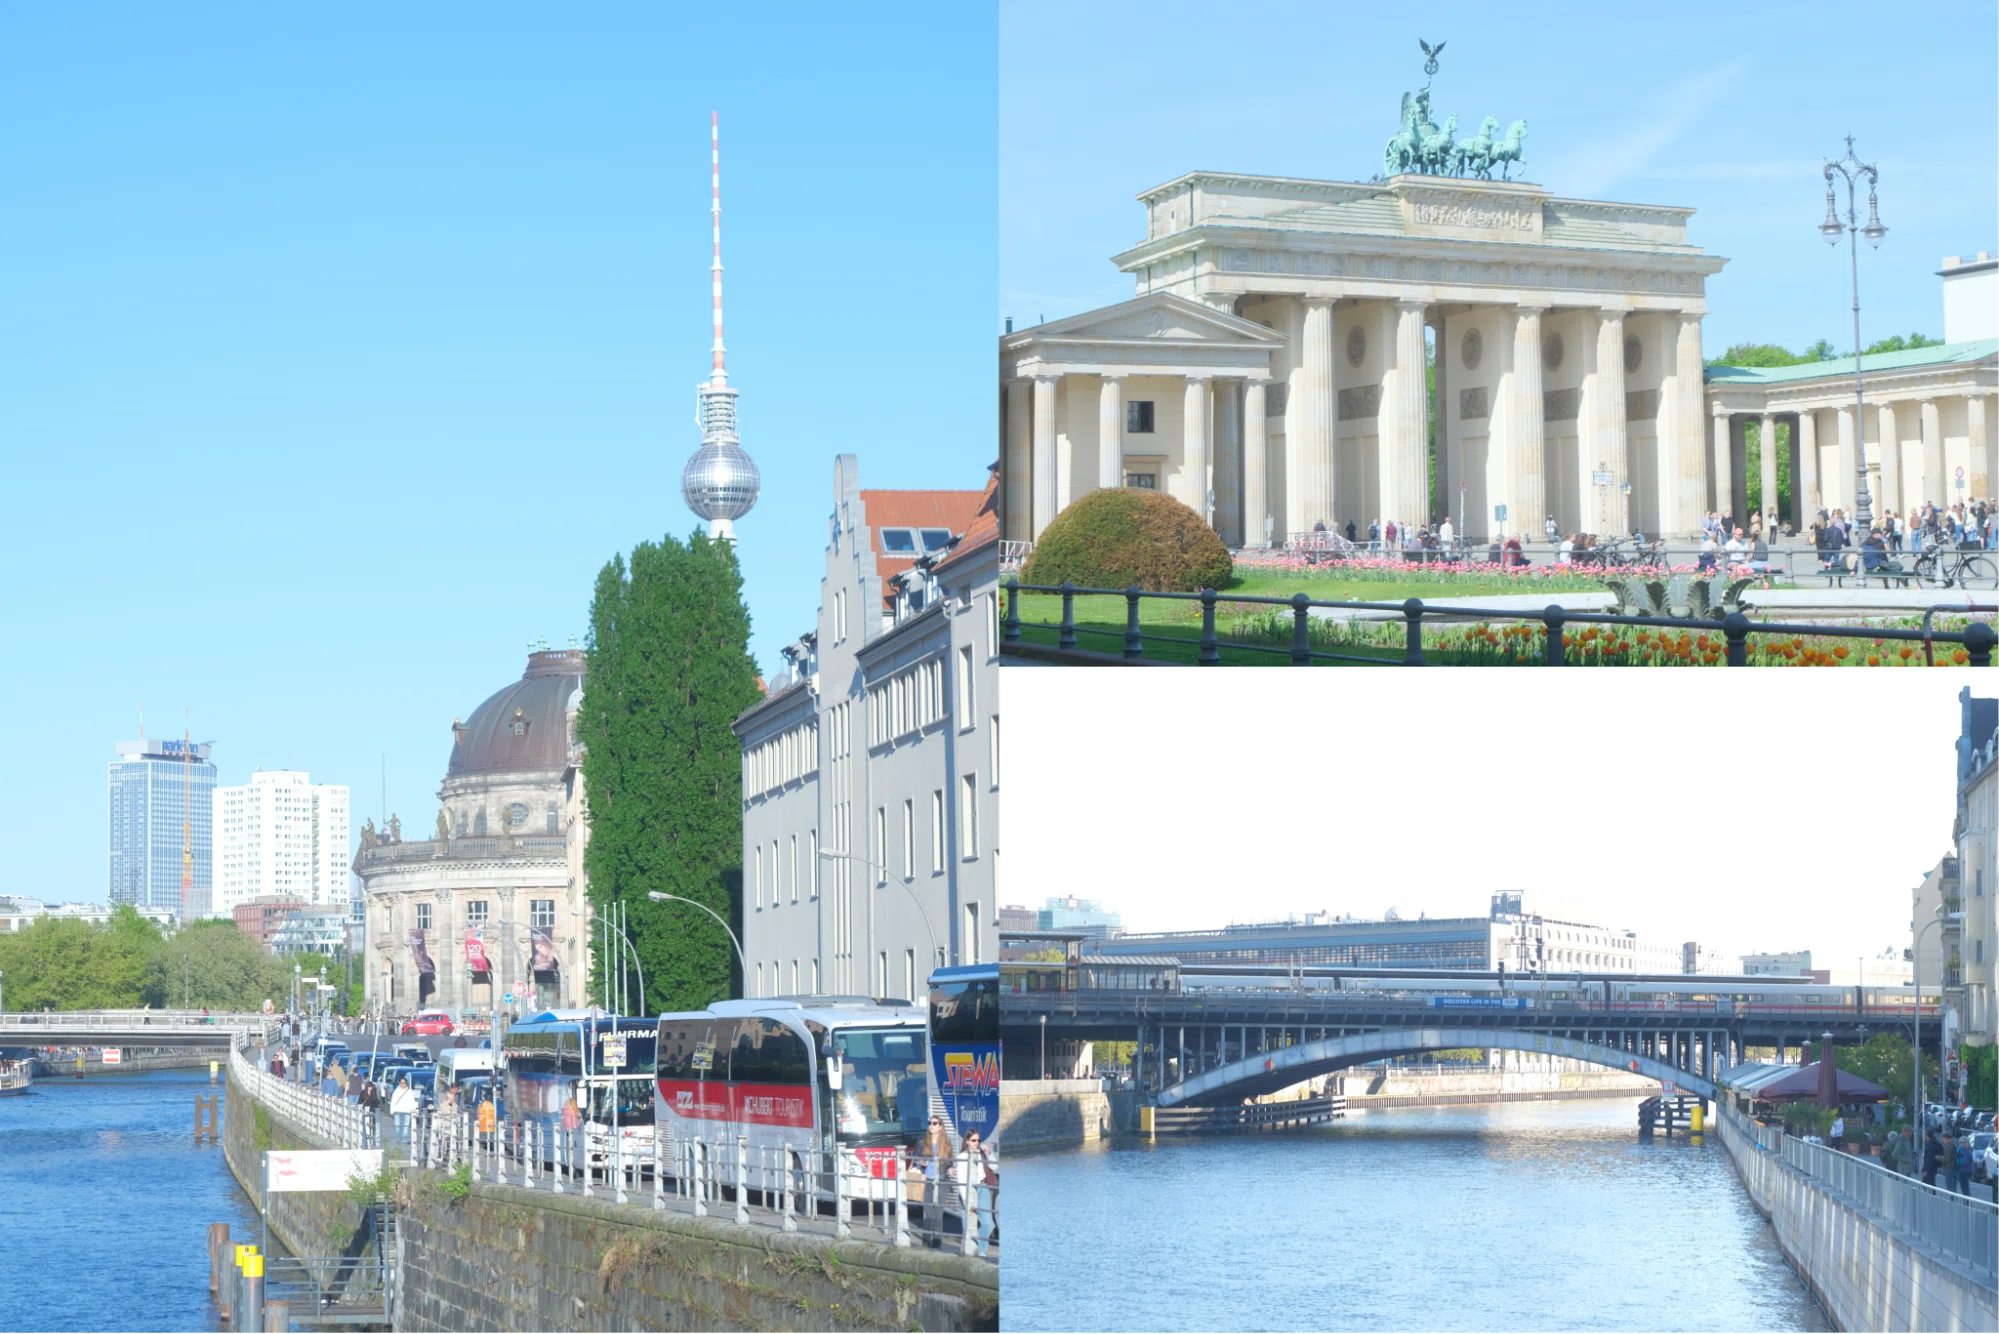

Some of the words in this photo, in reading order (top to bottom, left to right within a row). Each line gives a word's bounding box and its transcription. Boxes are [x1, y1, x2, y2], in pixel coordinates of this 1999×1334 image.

[467, 944, 482, 953] 120
[943, 1050, 999, 1097] STEWA
[774, 1097, 805, 1118] TOURISTIK
[960, 1105, 987, 1122] Touristik
